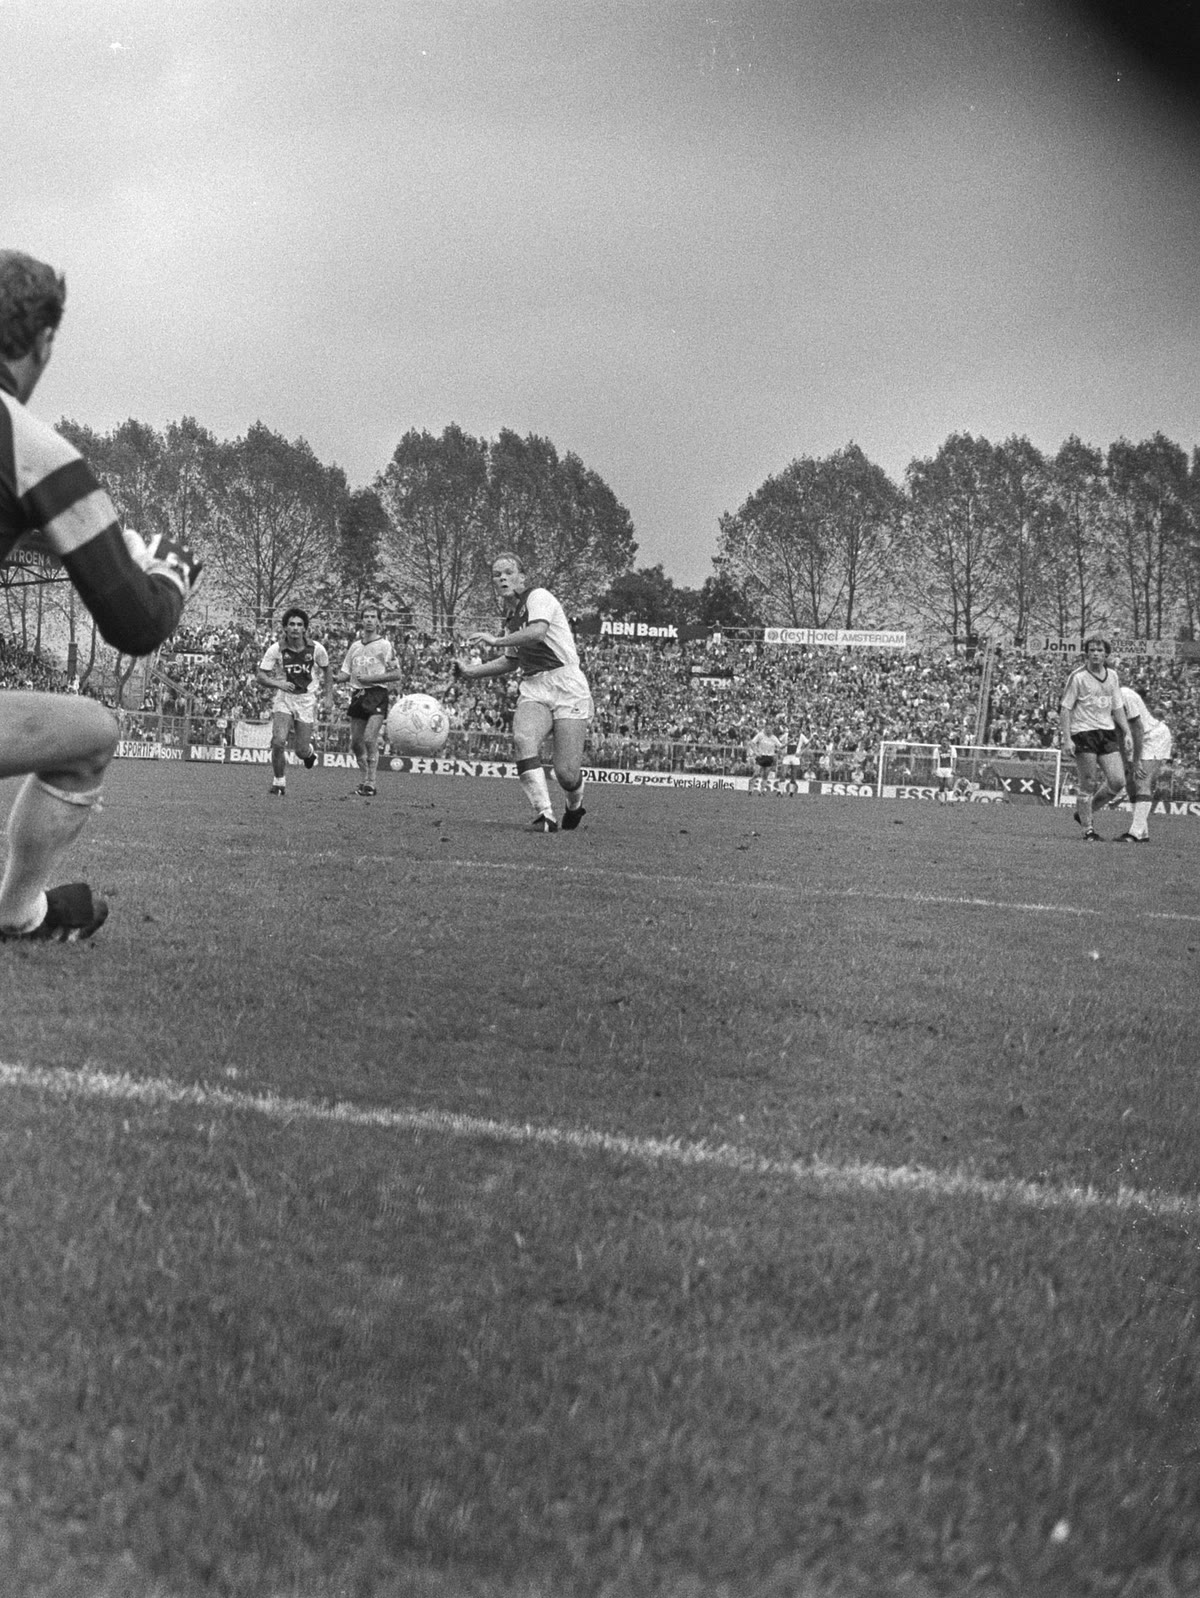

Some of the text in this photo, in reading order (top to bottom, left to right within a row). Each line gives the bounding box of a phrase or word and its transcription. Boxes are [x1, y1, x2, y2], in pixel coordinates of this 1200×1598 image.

[600, 621, 678, 638] ABN Bank
[841, 633, 905, 645] AMSTERDAM
[1043, 638, 1076, 652] John
[184, 653, 215, 664] TDK
[284, 663, 311, 674] TDK
[700, 677, 731, 688] TDK
[161, 748, 183, 759] SONY
[190, 746, 273, 764] NMB BANK
[323, 753, 360, 769] BAN
[580, 769, 735, 790] PAROOL sport verslaat alles
[821, 782, 873, 797] ESSO
